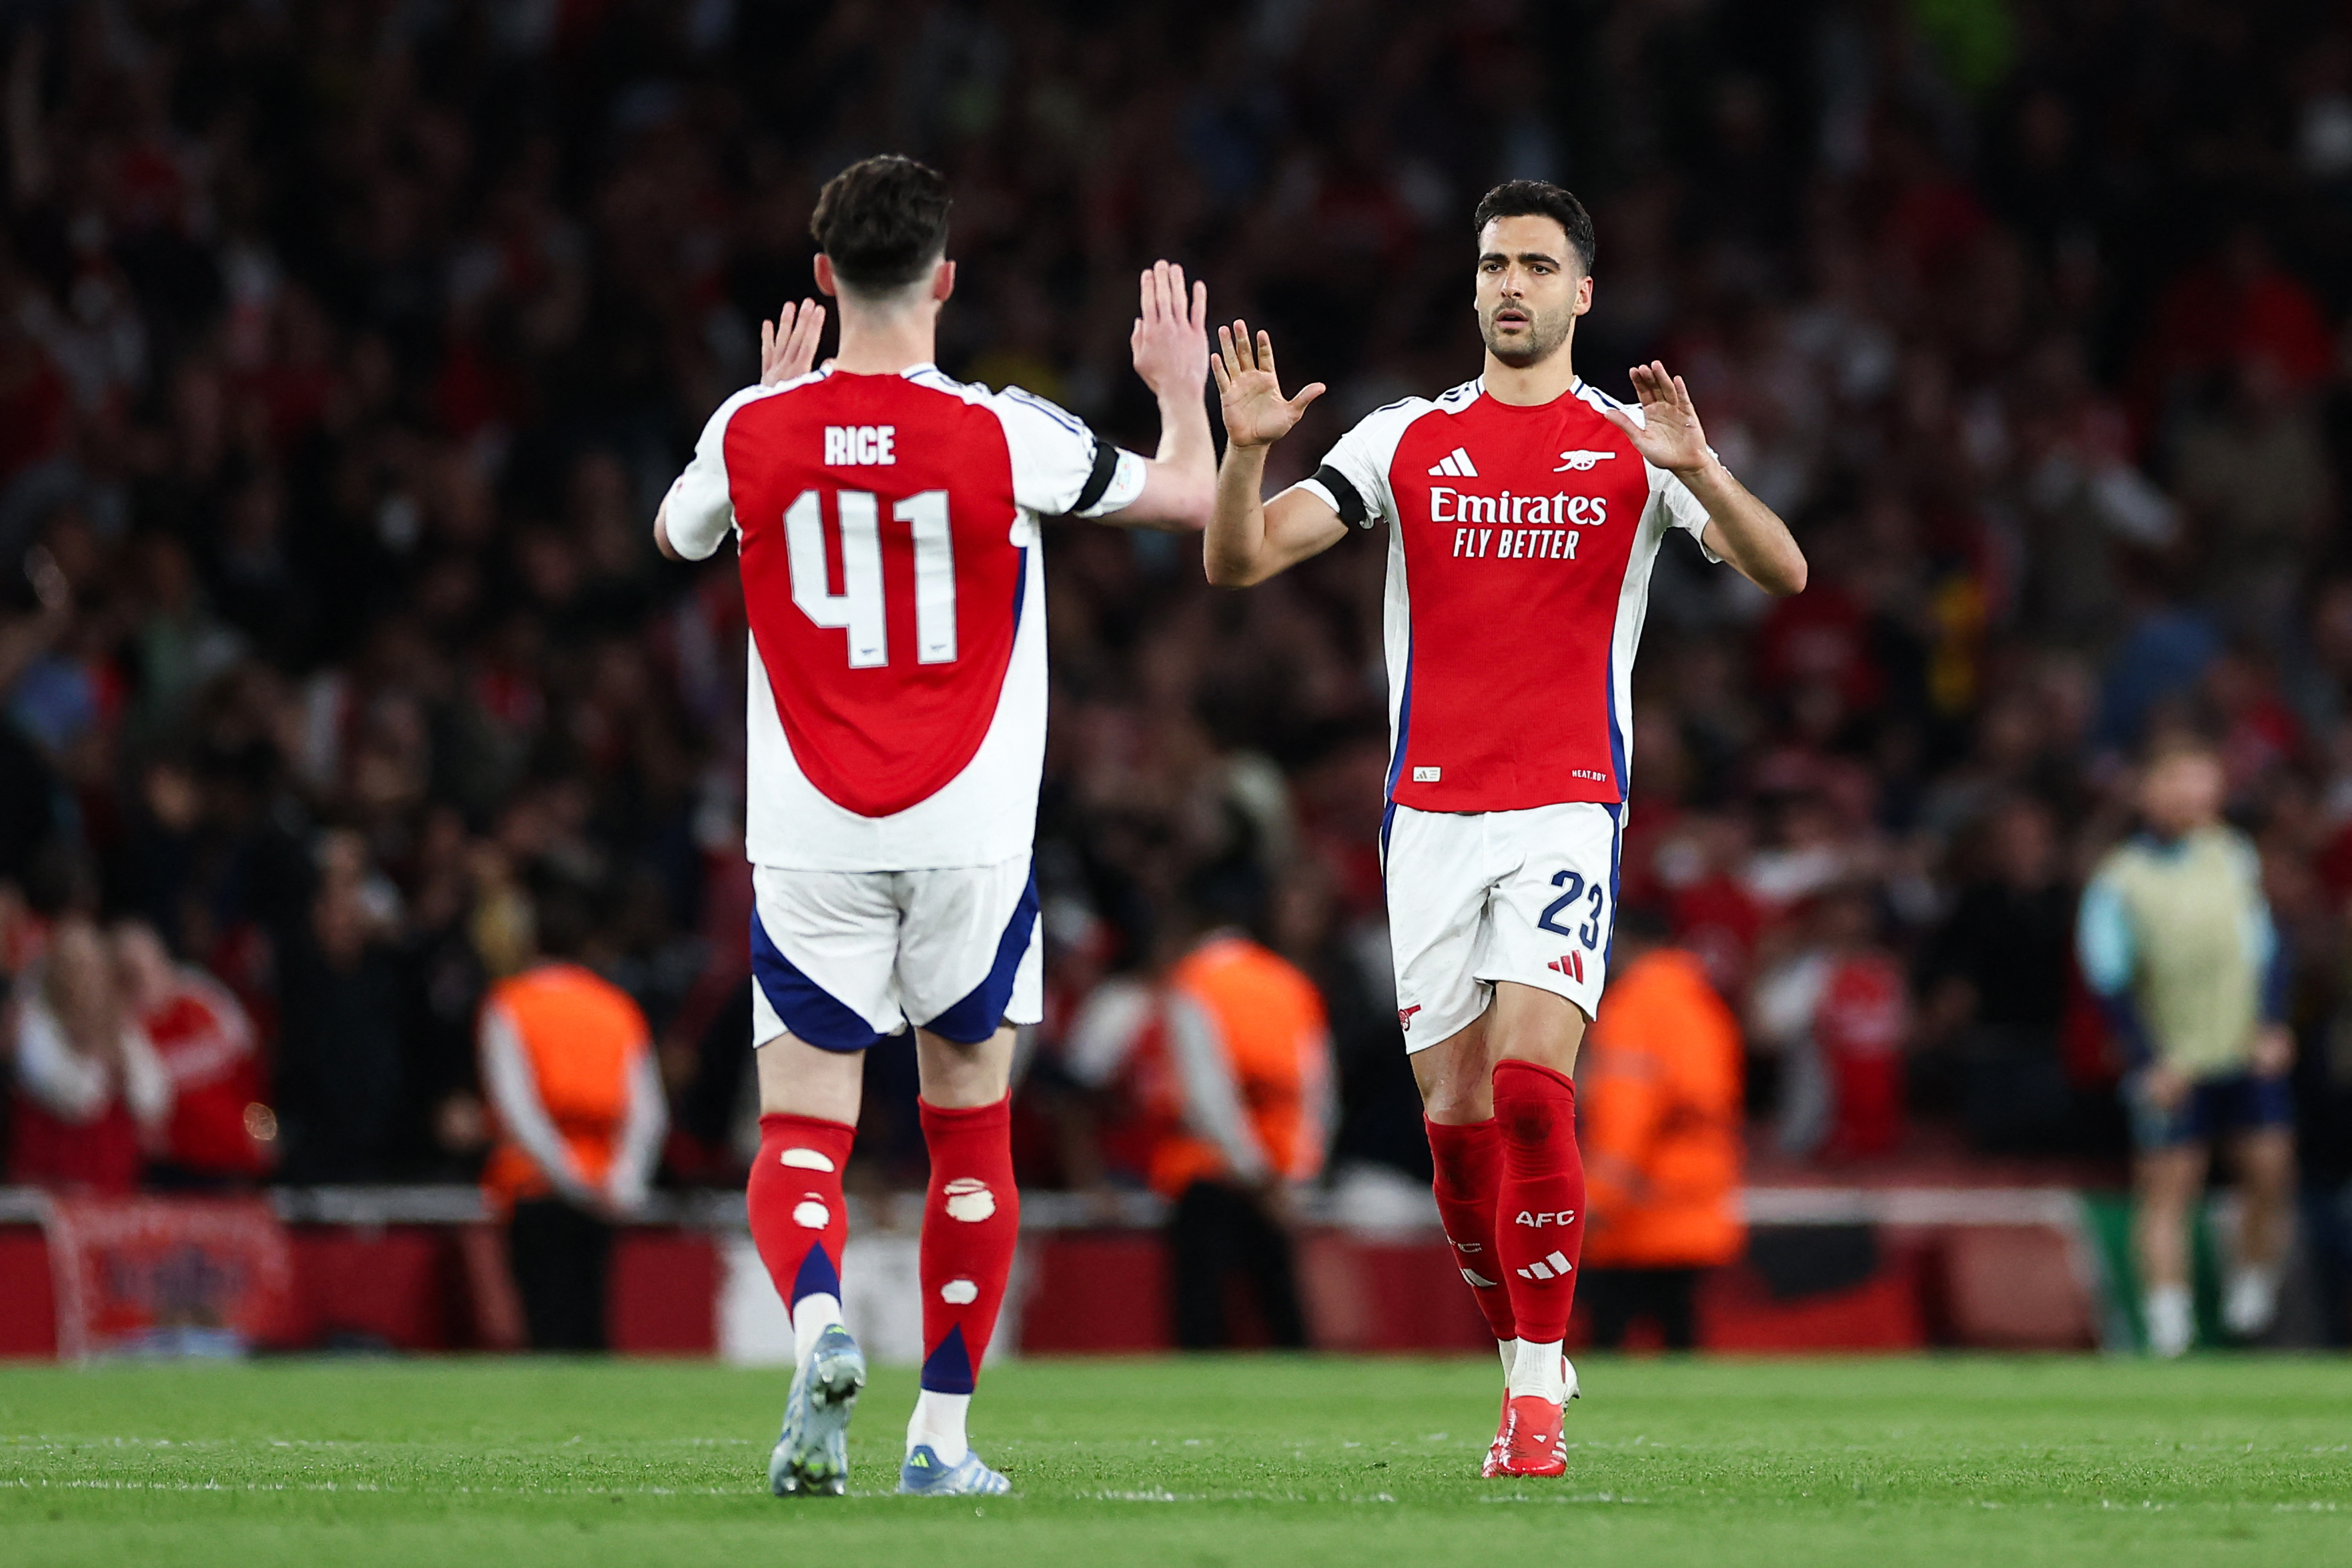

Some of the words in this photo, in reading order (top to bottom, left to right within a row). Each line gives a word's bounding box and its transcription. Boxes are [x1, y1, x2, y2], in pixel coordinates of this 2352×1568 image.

[824, 425, 896, 466] RICE
[1430, 487, 1607, 526] Emirates
[1453, 528, 1493, 558] FLY
[1497, 529, 1579, 560] BETTER
[783, 488, 957, 669] 41
[1571, 769, 1607, 783] HEAT.RDY
[1535, 868, 1603, 951] 23
[1515, 1210, 1575, 1228] AFC
